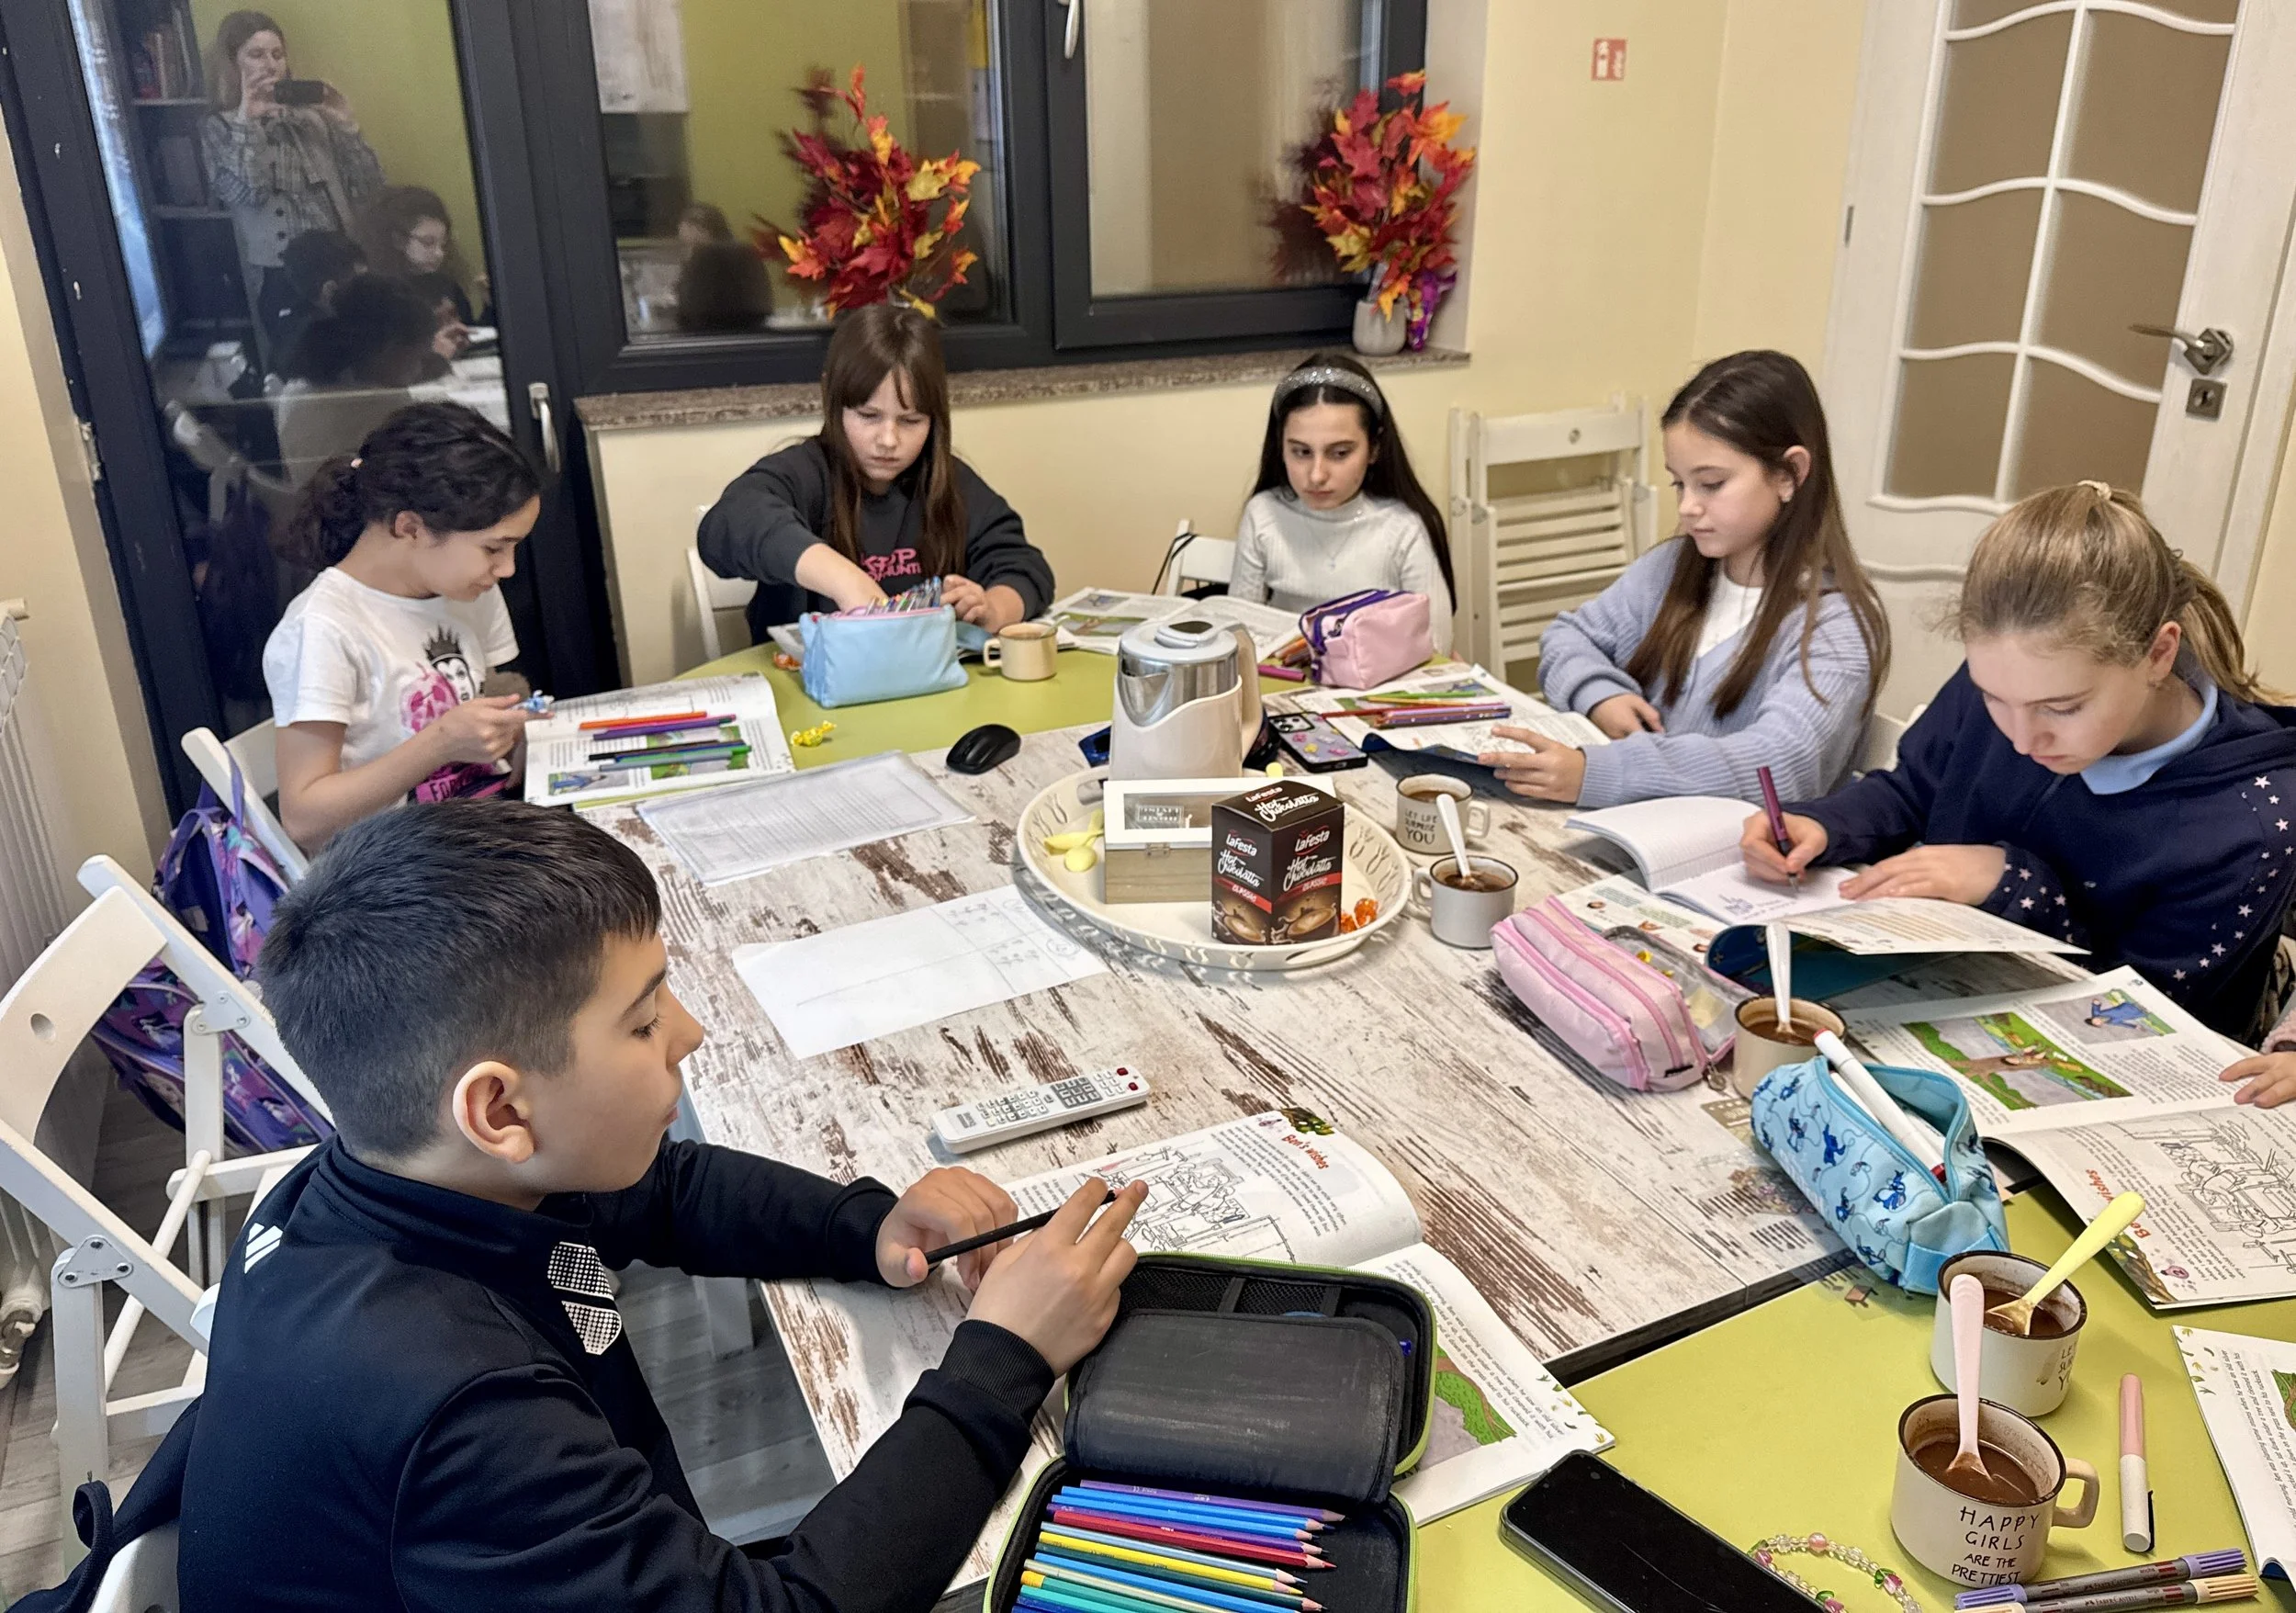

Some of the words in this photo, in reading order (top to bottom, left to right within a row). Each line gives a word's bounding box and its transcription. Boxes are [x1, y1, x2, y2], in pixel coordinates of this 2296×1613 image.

[1226, 833, 1257, 857] LaFesta
[1295, 830, 1330, 852] LaFesta
[1406, 827, 1435, 845] YOU
[1220, 850, 1246, 865] Hot
[1287, 855, 1318, 872] Hot
[1960, 1506, 2040, 1532] HAPPY
[1965, 1531, 2025, 1550] GIRLS
[1964, 1554, 1989, 1567] ARE
[1996, 1557, 2016, 1568] THE
[1952, 1564, 2021, 1585] PRETTIEST
